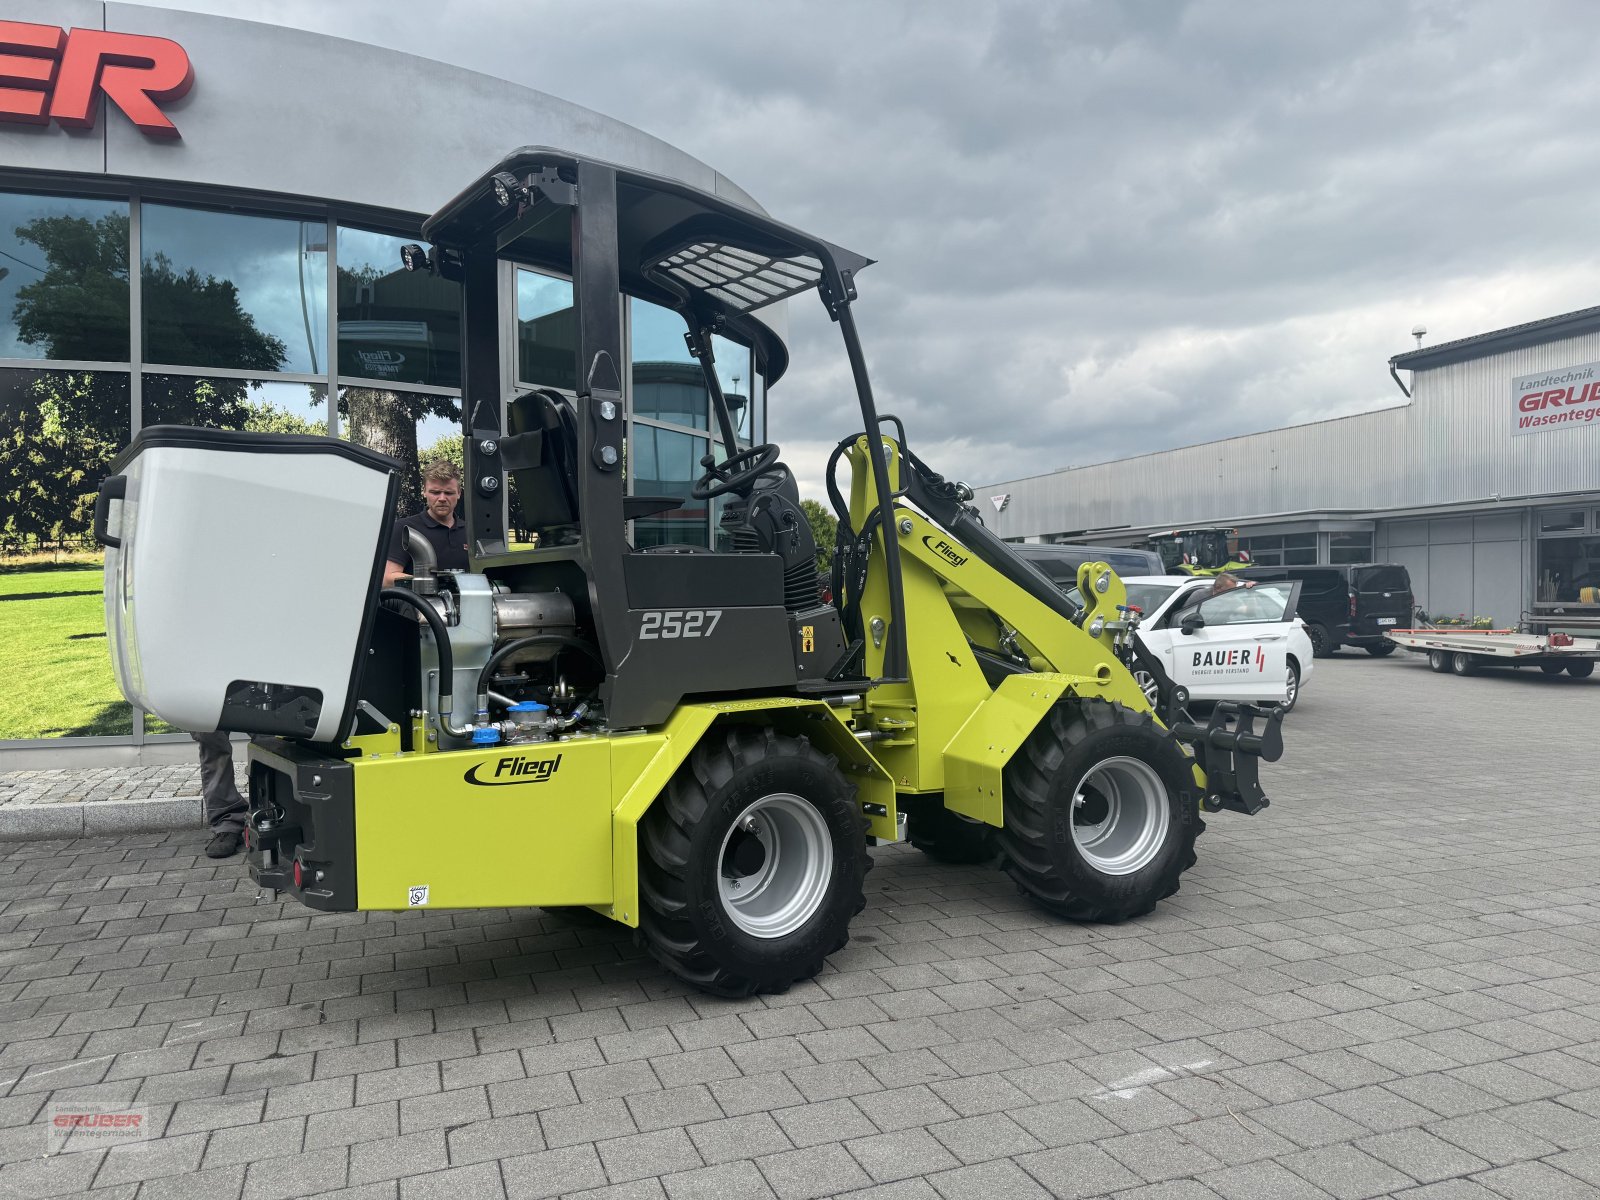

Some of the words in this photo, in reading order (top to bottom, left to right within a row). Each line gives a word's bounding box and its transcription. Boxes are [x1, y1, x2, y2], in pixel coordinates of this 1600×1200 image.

[1520, 368, 1594, 390] Landtechnik
[935, 541, 968, 566] Fliegl
[639, 610, 722, 640] 2527
[1193, 650, 1250, 666] BAUER
[494, 754, 562, 778] Fliegl
